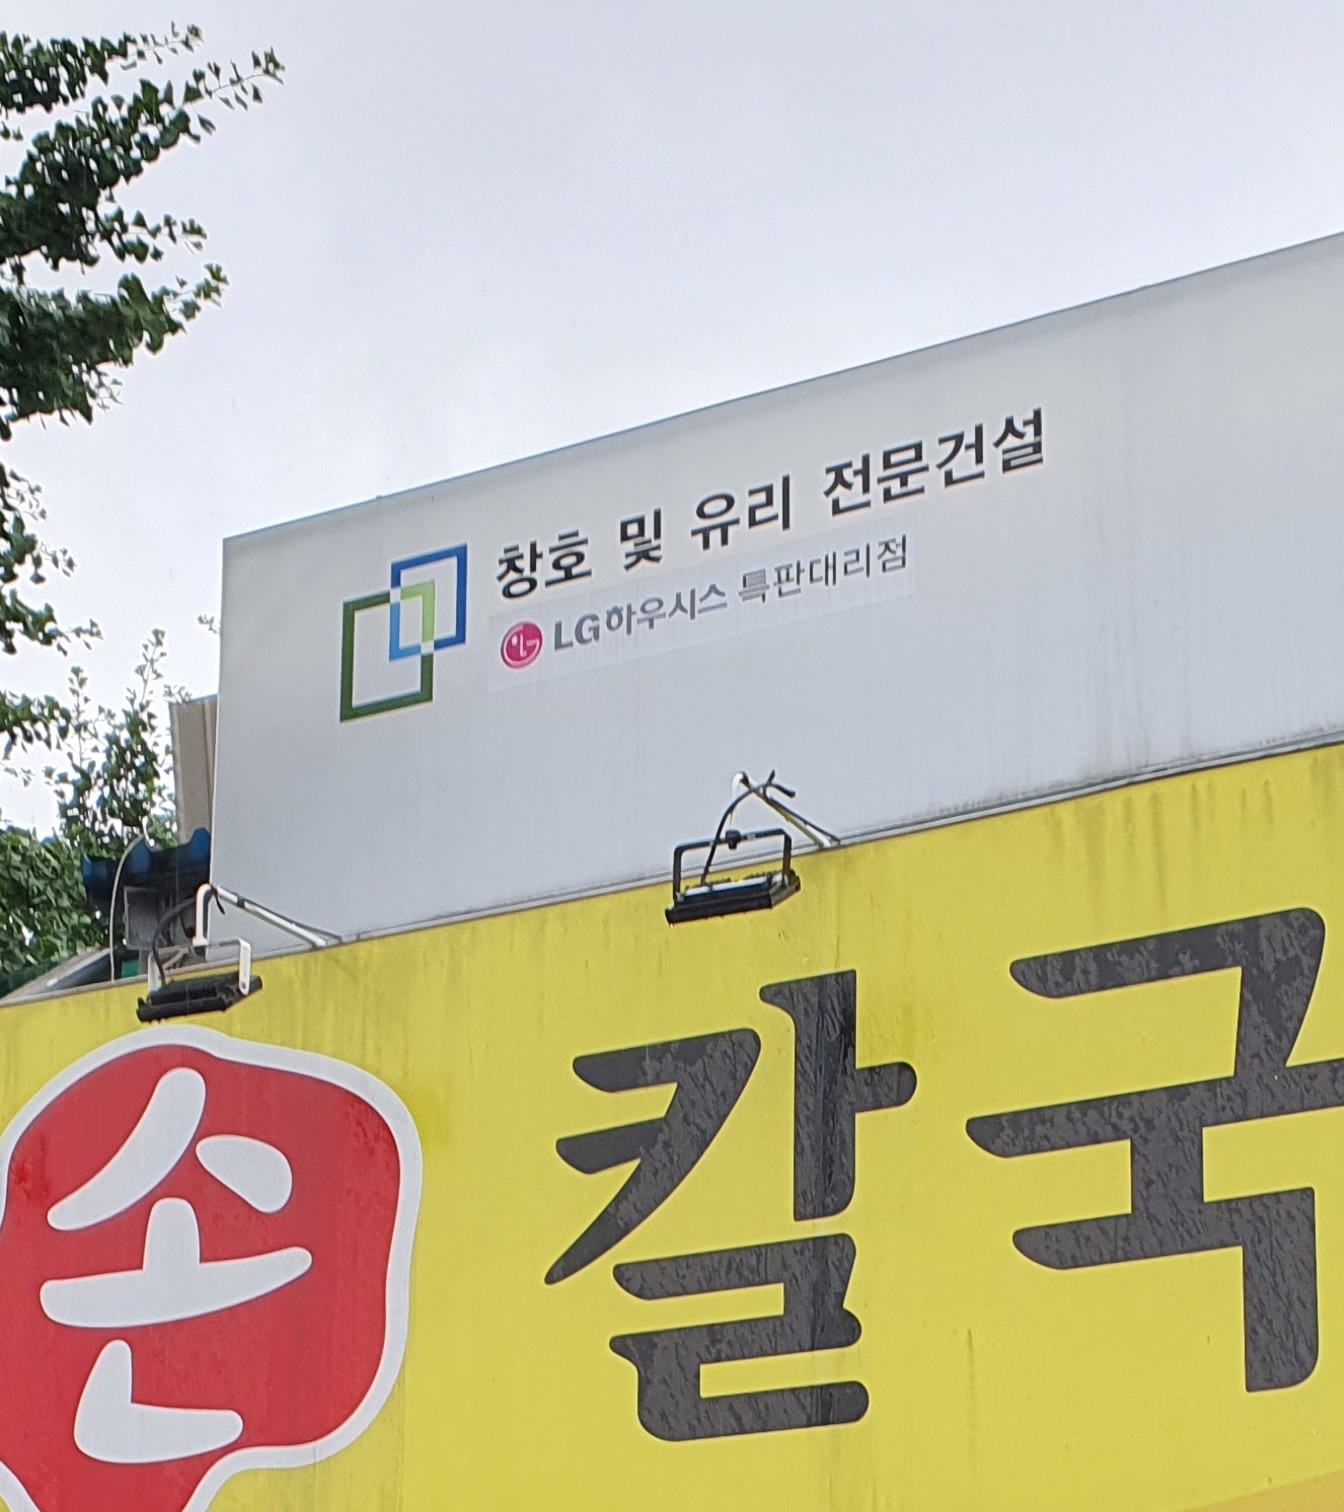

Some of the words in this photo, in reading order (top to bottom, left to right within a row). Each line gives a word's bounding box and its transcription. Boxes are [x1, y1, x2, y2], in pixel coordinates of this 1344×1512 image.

[494, 528, 590, 601] 창호
[619, 507, 663, 567] 및
[689, 475, 793, 551] 유리
[822, 407, 1046, 519] 전문건설
[737, 533, 910, 606] 특판대리점
[39, 1066, 313, 1466] 손
